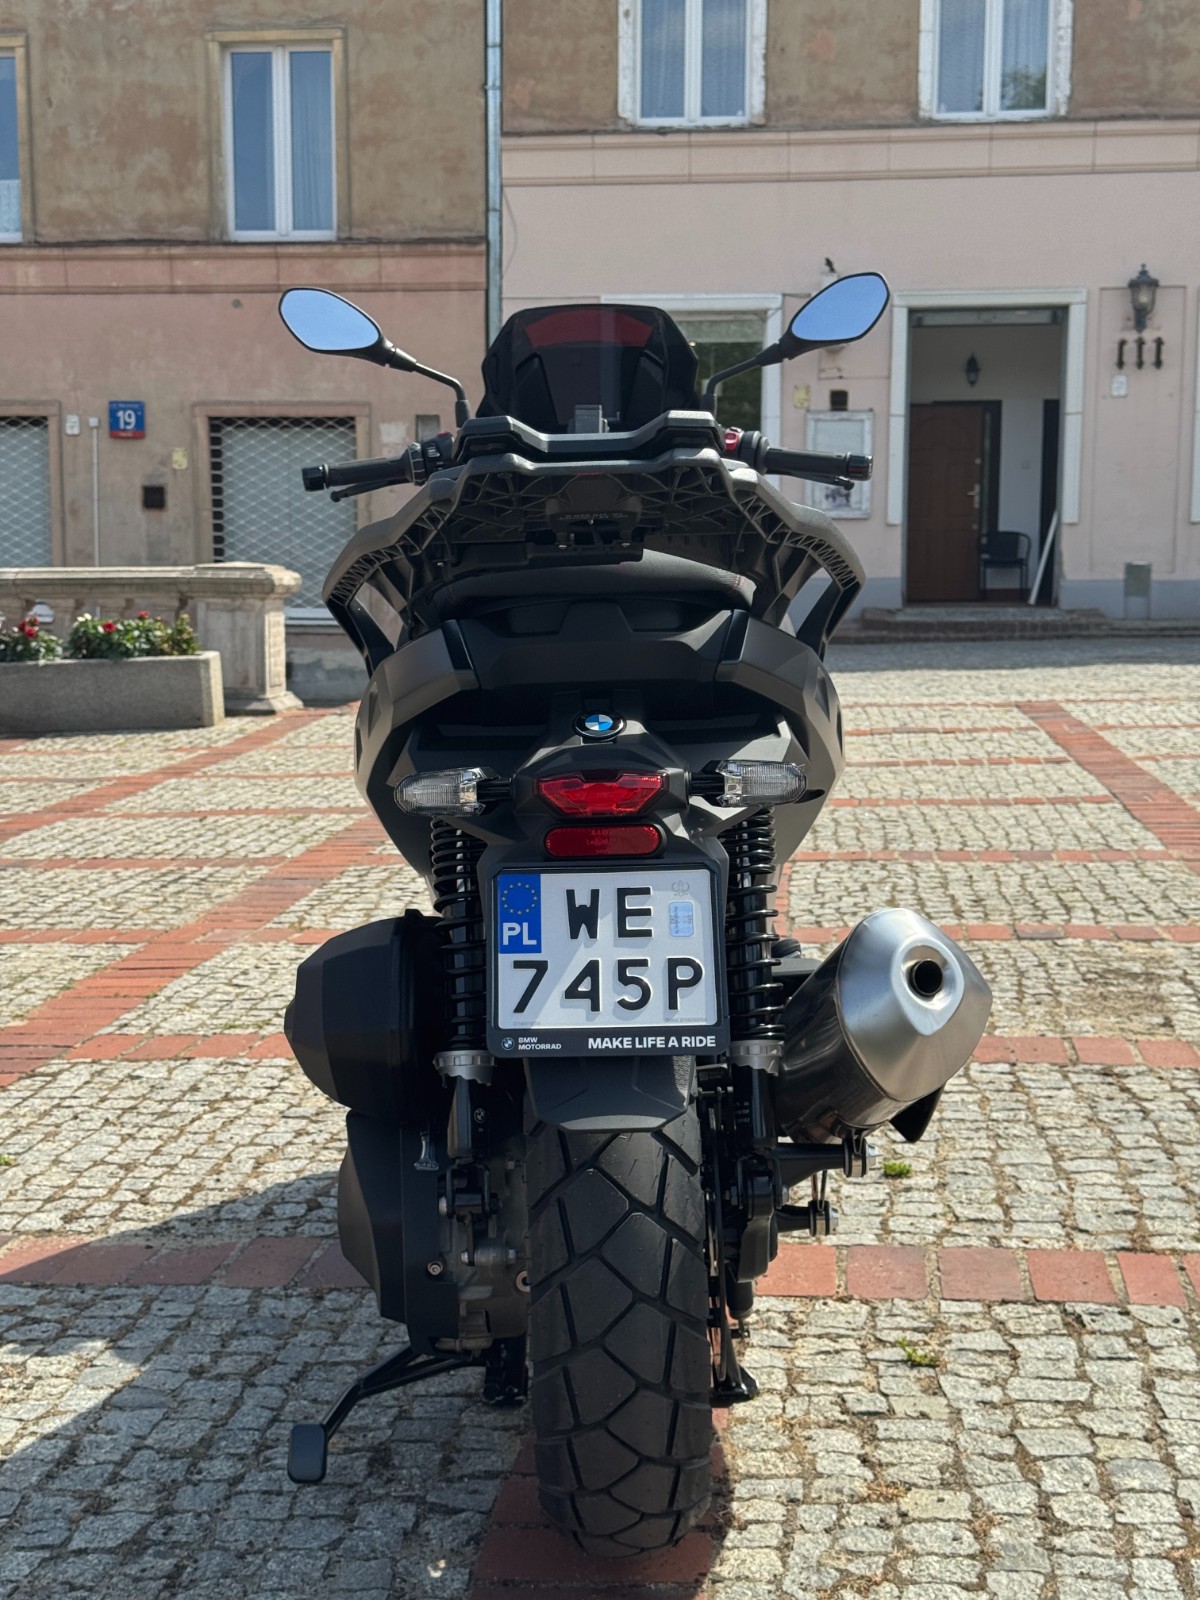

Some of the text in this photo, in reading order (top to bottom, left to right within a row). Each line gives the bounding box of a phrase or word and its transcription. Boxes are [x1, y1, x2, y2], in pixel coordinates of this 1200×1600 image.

[116, 409, 136, 430] 19
[565, 886, 653, 940] WE
[502, 922, 538, 946] PL
[512, 957, 704, 1014] 745P
[518, 1043, 562, 1051] MOTORRAD
[588, 1035, 717, 1050] MAKE LIFE A RIDE
